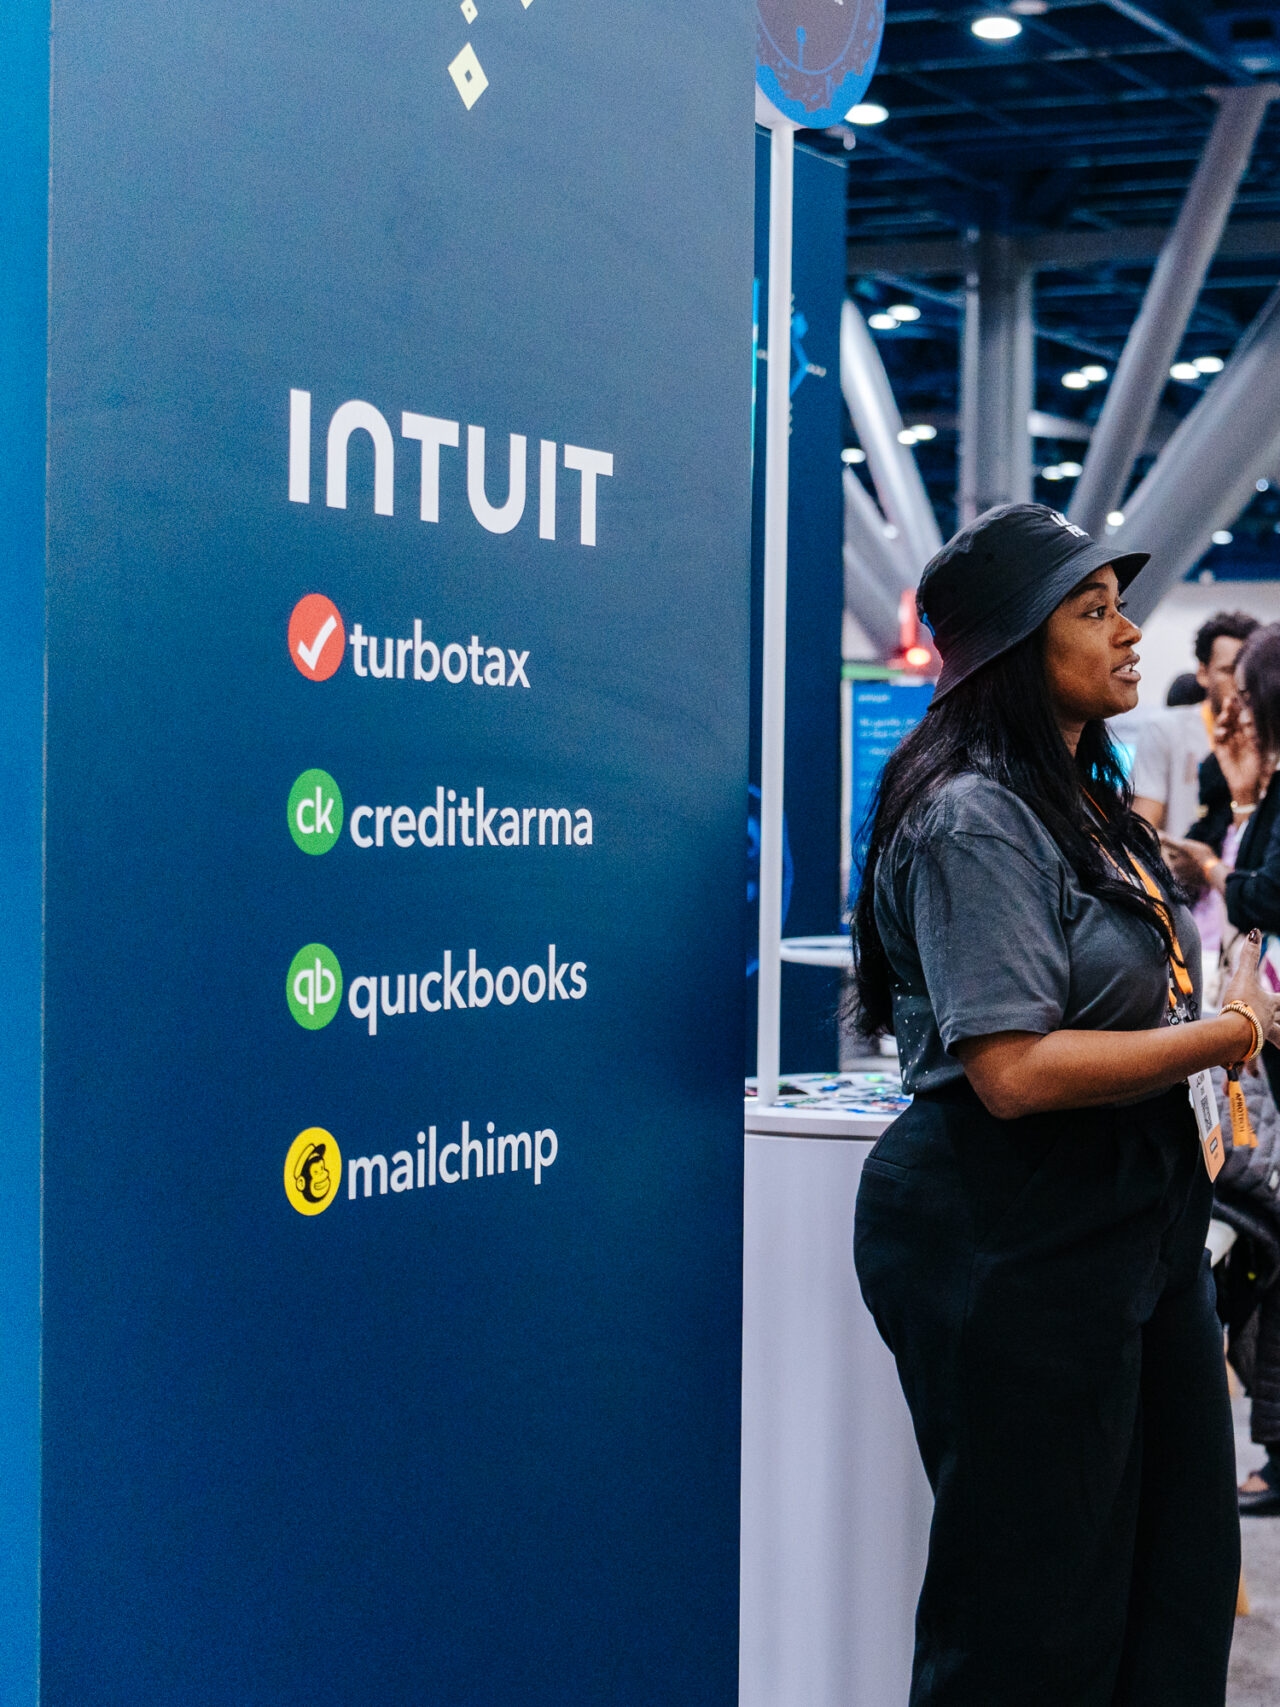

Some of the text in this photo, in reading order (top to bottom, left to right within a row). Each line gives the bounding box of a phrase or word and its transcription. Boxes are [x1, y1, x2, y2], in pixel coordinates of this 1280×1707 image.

[289, 388, 614, 547] INTUIT
[349, 618, 531, 688] turbotax
[296, 786, 593, 848] ck creditkarma
[348, 943, 588, 1036] quickbooks
[348, 1121, 559, 1200] mailchimp
